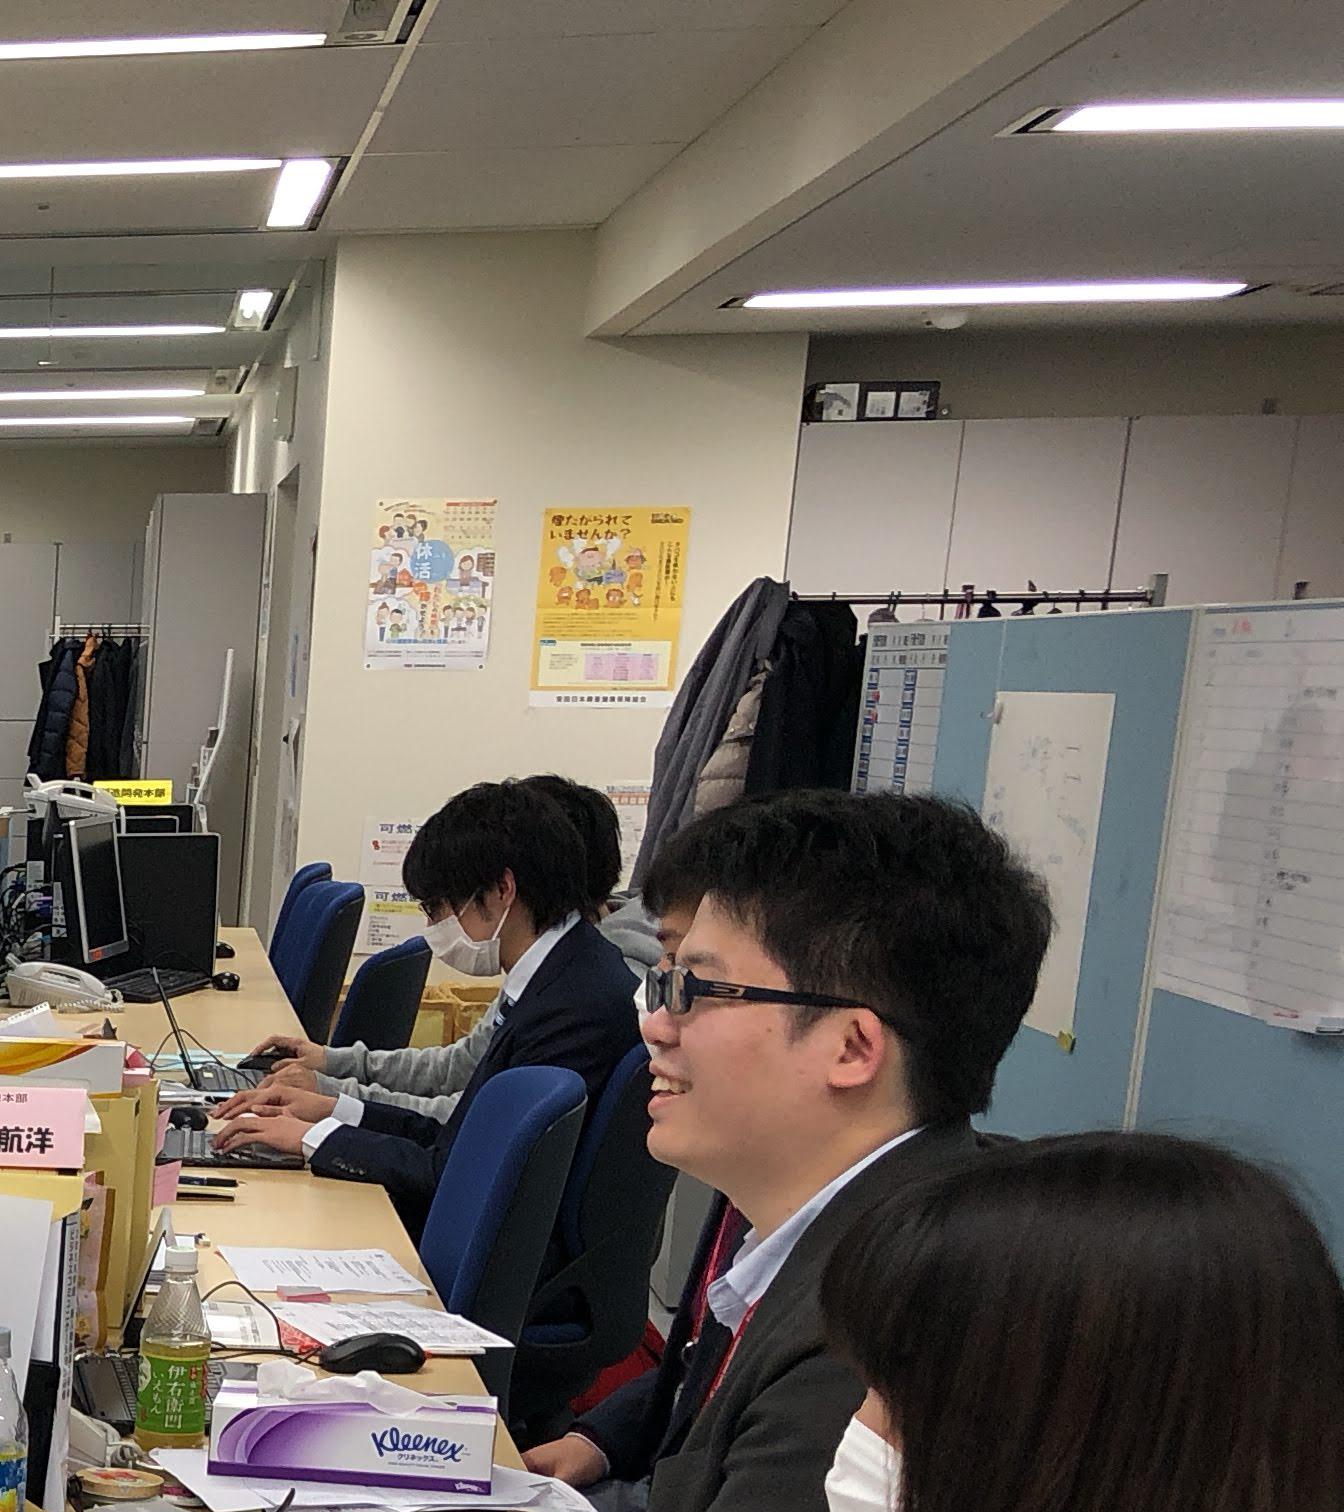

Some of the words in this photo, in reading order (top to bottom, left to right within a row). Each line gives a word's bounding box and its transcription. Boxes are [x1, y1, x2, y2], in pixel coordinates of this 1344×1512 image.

[101, 787, 166, 799] 造開発本部
[150, 1370, 165, 1415] いえもん
[371, 1426, 465, 1463] Kleenex
[396, 1453, 435, 1462] クリネックス
